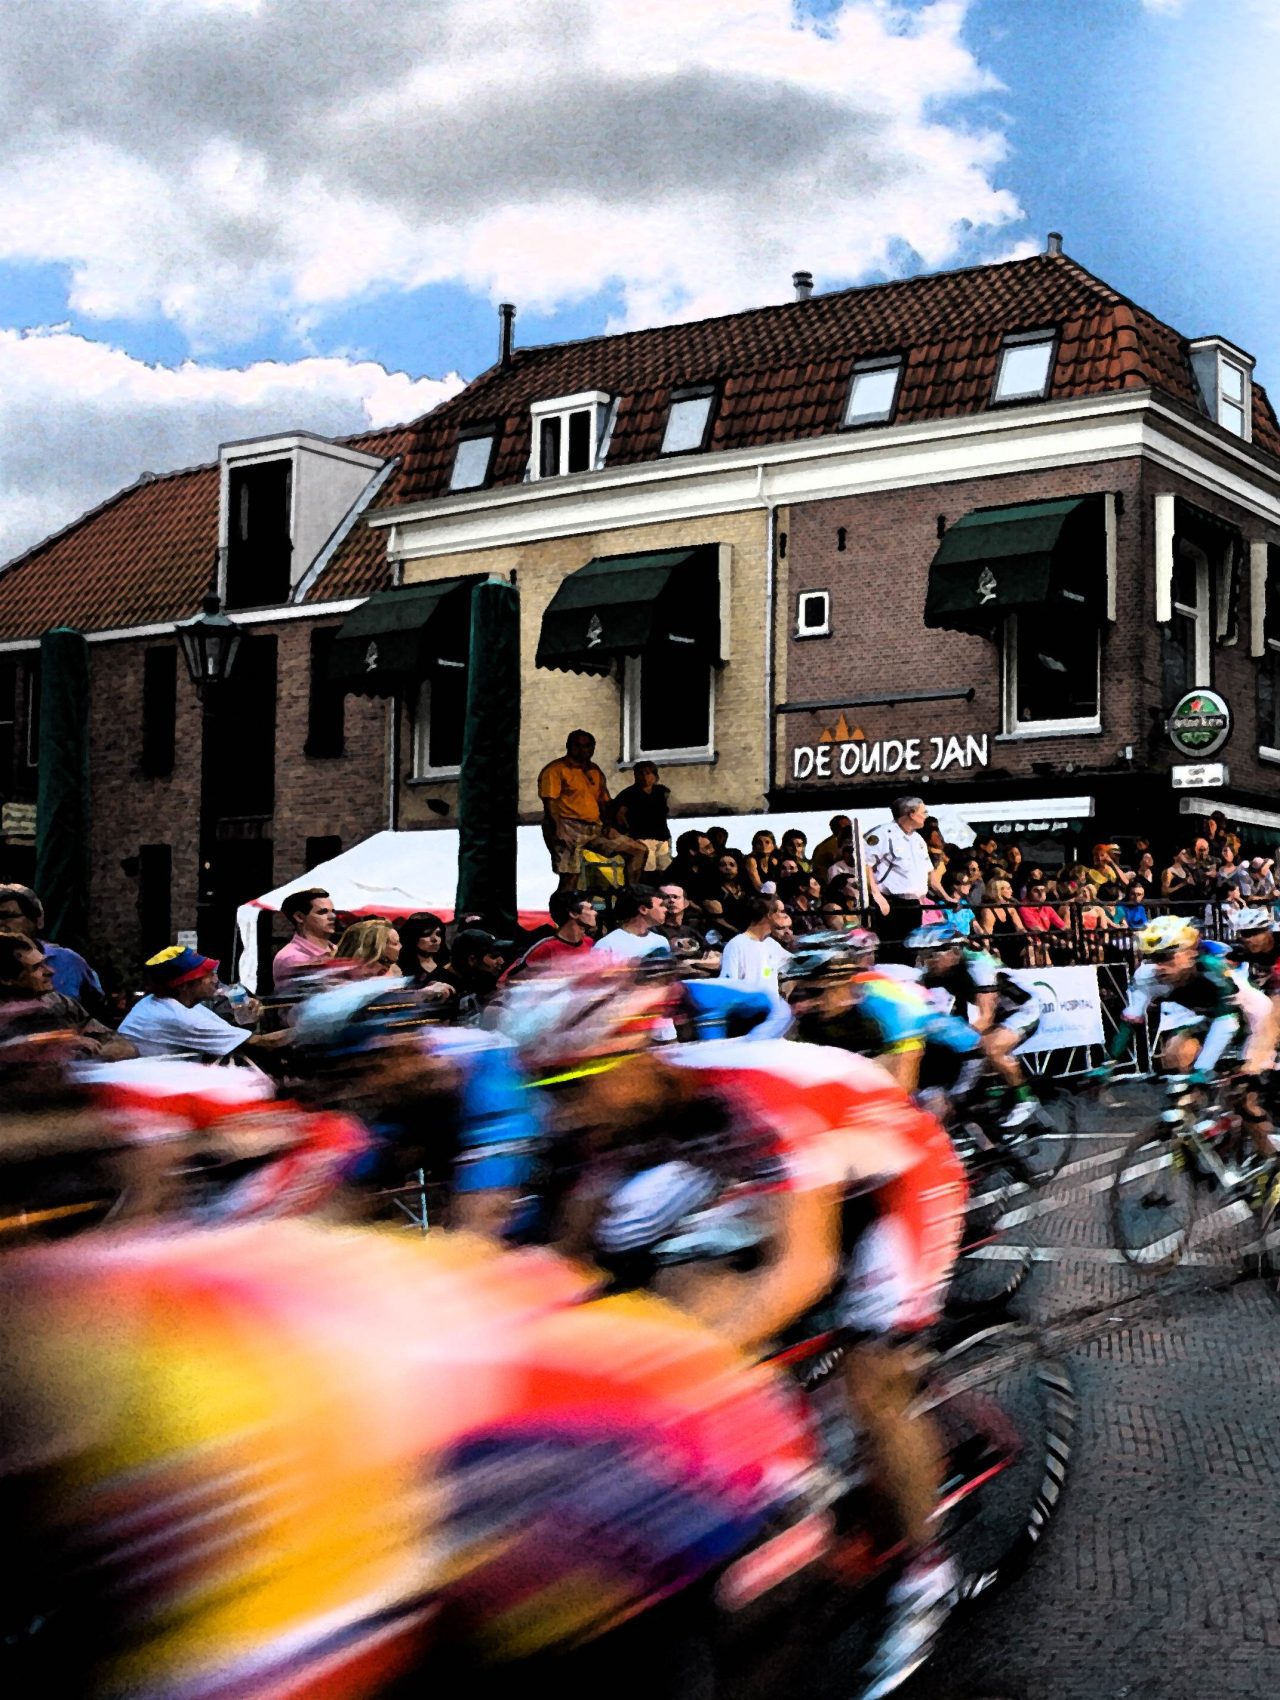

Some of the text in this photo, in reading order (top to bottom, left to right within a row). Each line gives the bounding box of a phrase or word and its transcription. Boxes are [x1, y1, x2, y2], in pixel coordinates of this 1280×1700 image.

[793, 733, 988, 779] DE OUDE JAN
